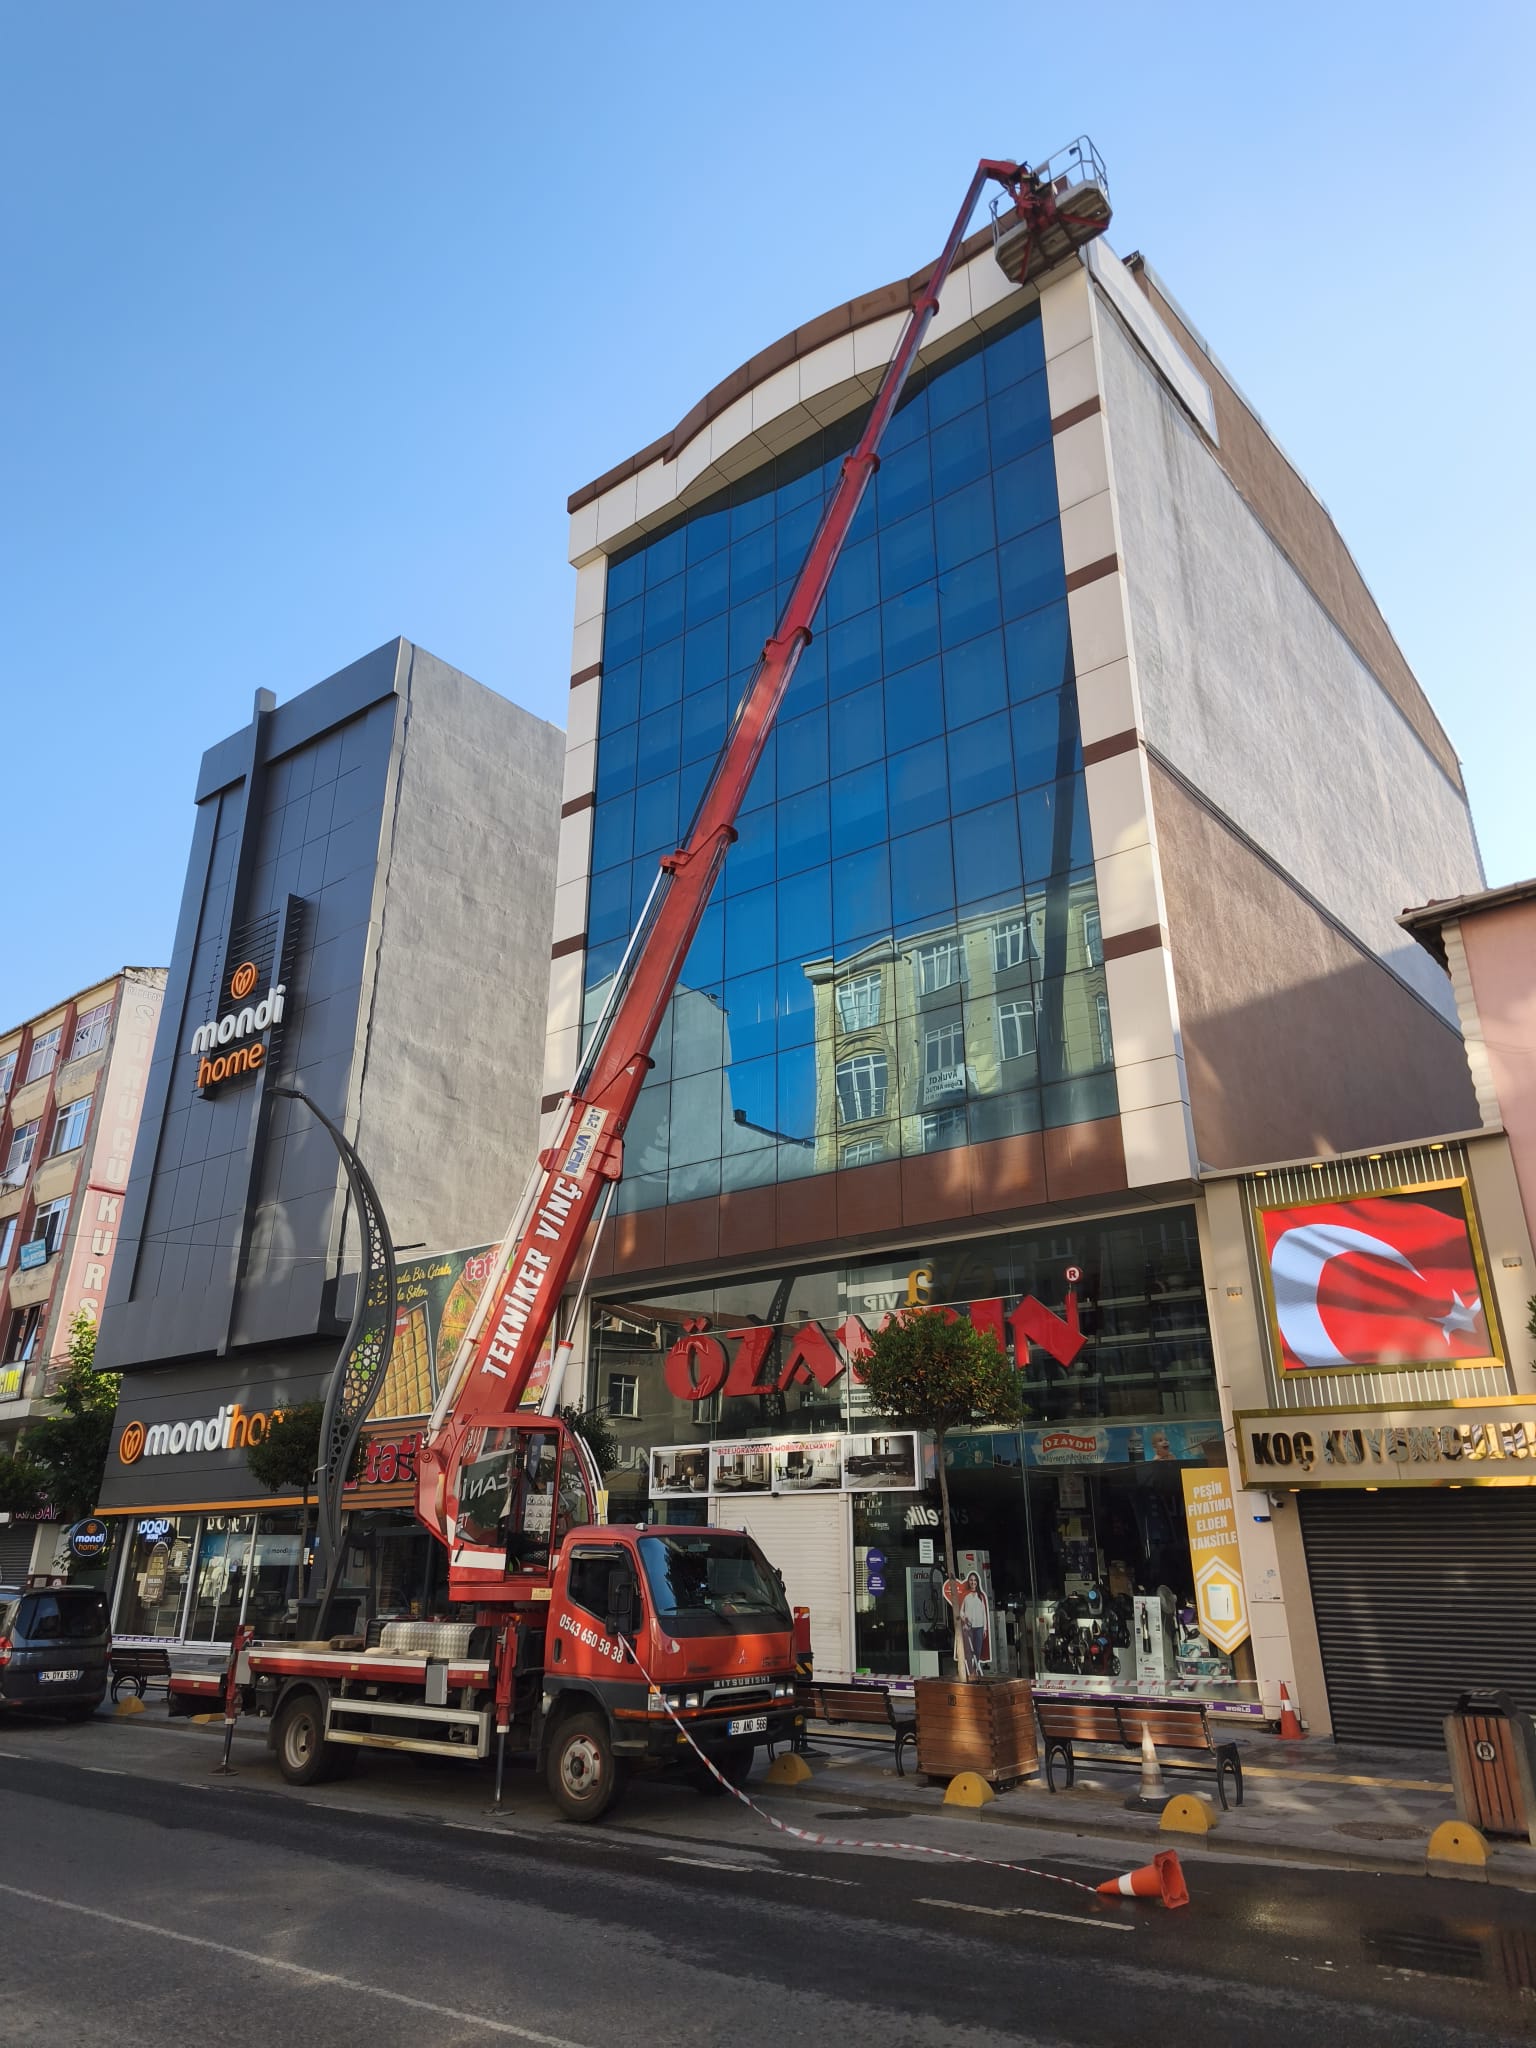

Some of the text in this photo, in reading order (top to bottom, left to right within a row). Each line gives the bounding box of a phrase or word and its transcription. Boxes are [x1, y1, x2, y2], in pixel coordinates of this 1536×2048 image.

[191, 984, 286, 1054] mondi
[198, 1044, 266, 1088] home
[466, 1253, 500, 1282] tat
[481, 1176, 583, 1379] TEKNİKER VİNÇ
[804, 1441, 835, 1450] ALMAYIN
[1043, 1437, 1096, 1450] ÖZAYDIN
[1251, 1431, 1314, 1472] KOÇ
[1193, 1481, 1222, 1500] PEŞİN
[1188, 1497, 1232, 1517] FİYATINA
[1196, 1515, 1228, 1533] ELDEN
[75, 1533, 105, 1543] mondi
[1191, 1531, 1238, 1550] TAKSİTLE
[560, 1613, 624, 1663] 0543 650 58 38
[713, 1676, 770, 1688] MITSUBISHI
[1225, 1705, 1251, 1713] WORLD
[732, 1723, 740, 1734] 59
